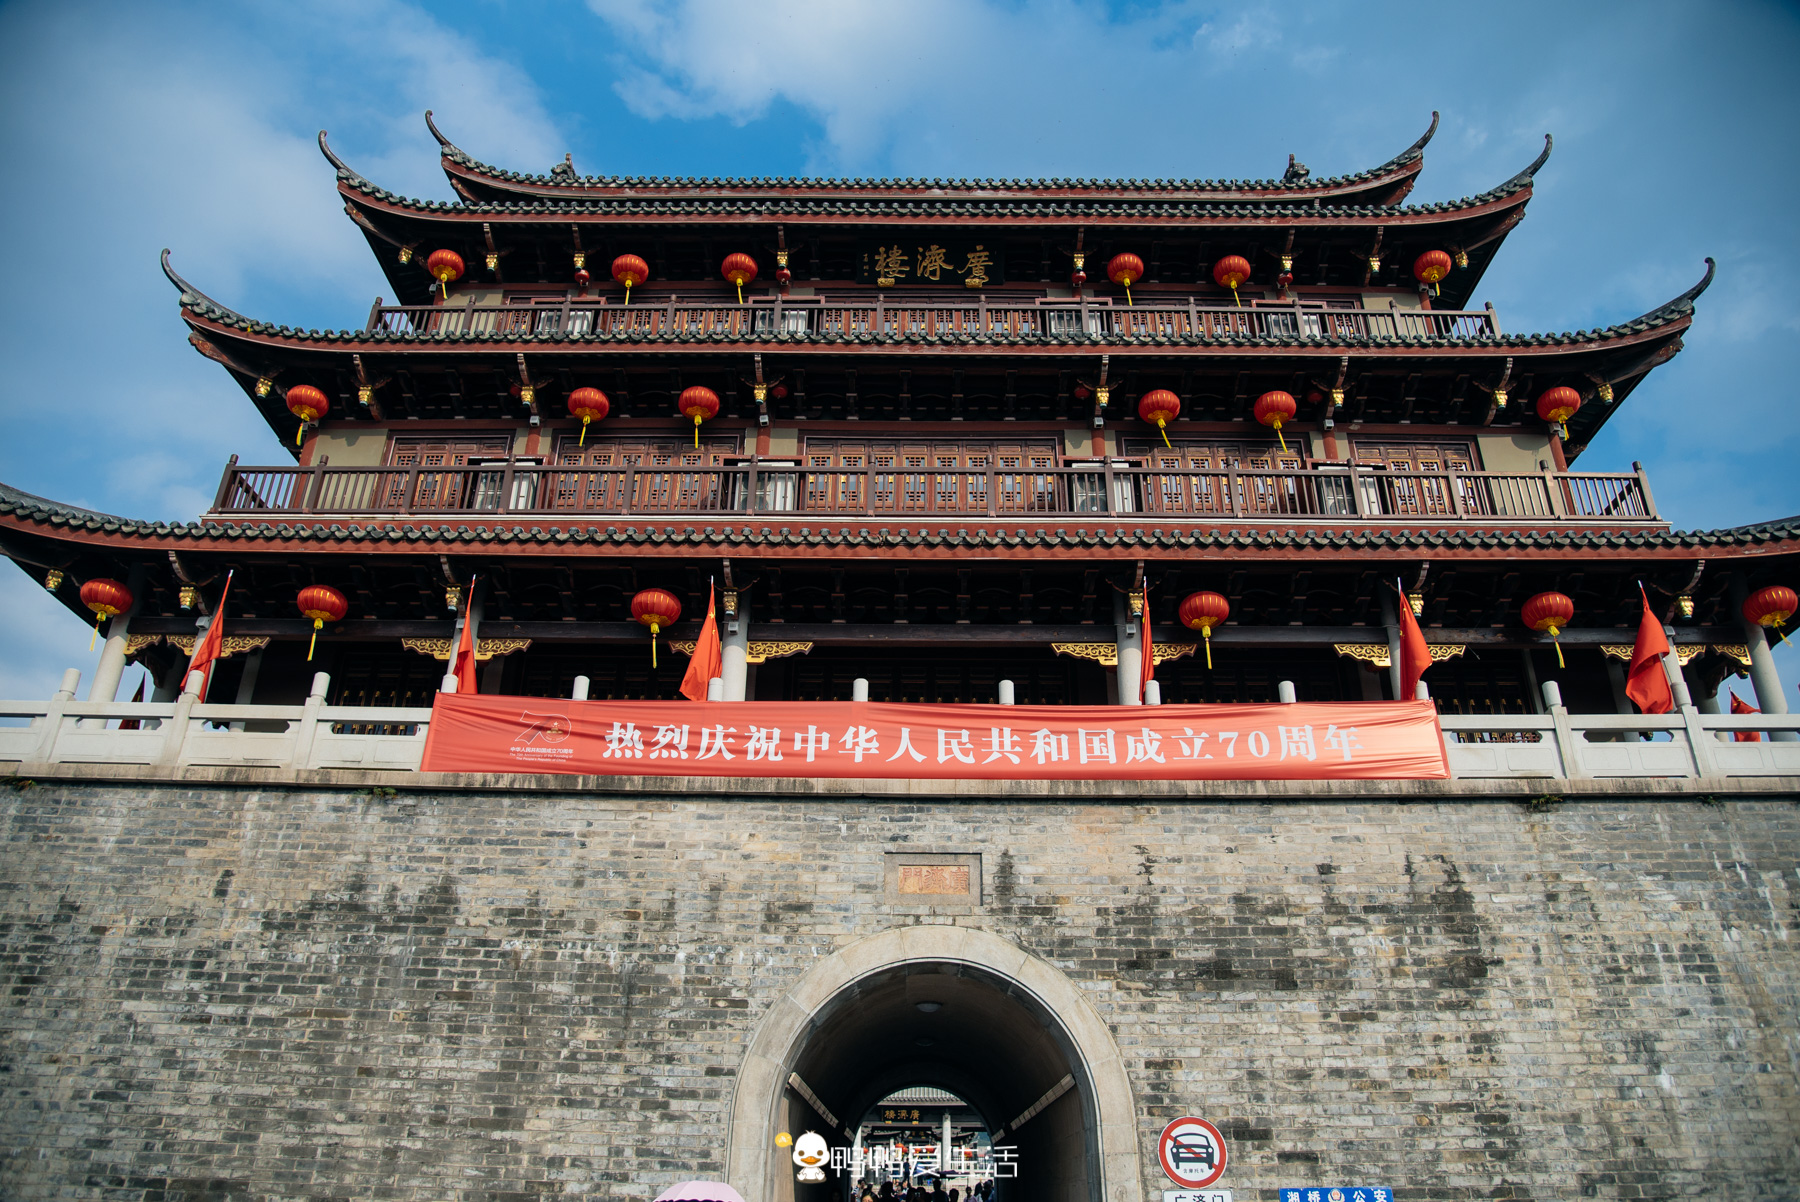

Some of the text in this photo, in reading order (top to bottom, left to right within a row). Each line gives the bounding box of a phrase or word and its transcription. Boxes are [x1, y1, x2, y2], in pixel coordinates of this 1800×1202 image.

[874, 244, 993, 283] 廣濟樓
[602, 721, 1365, 765] 热烈庆祝中华人民共和国成立70周年
[900, 866, 969, 891] 廣濟門
